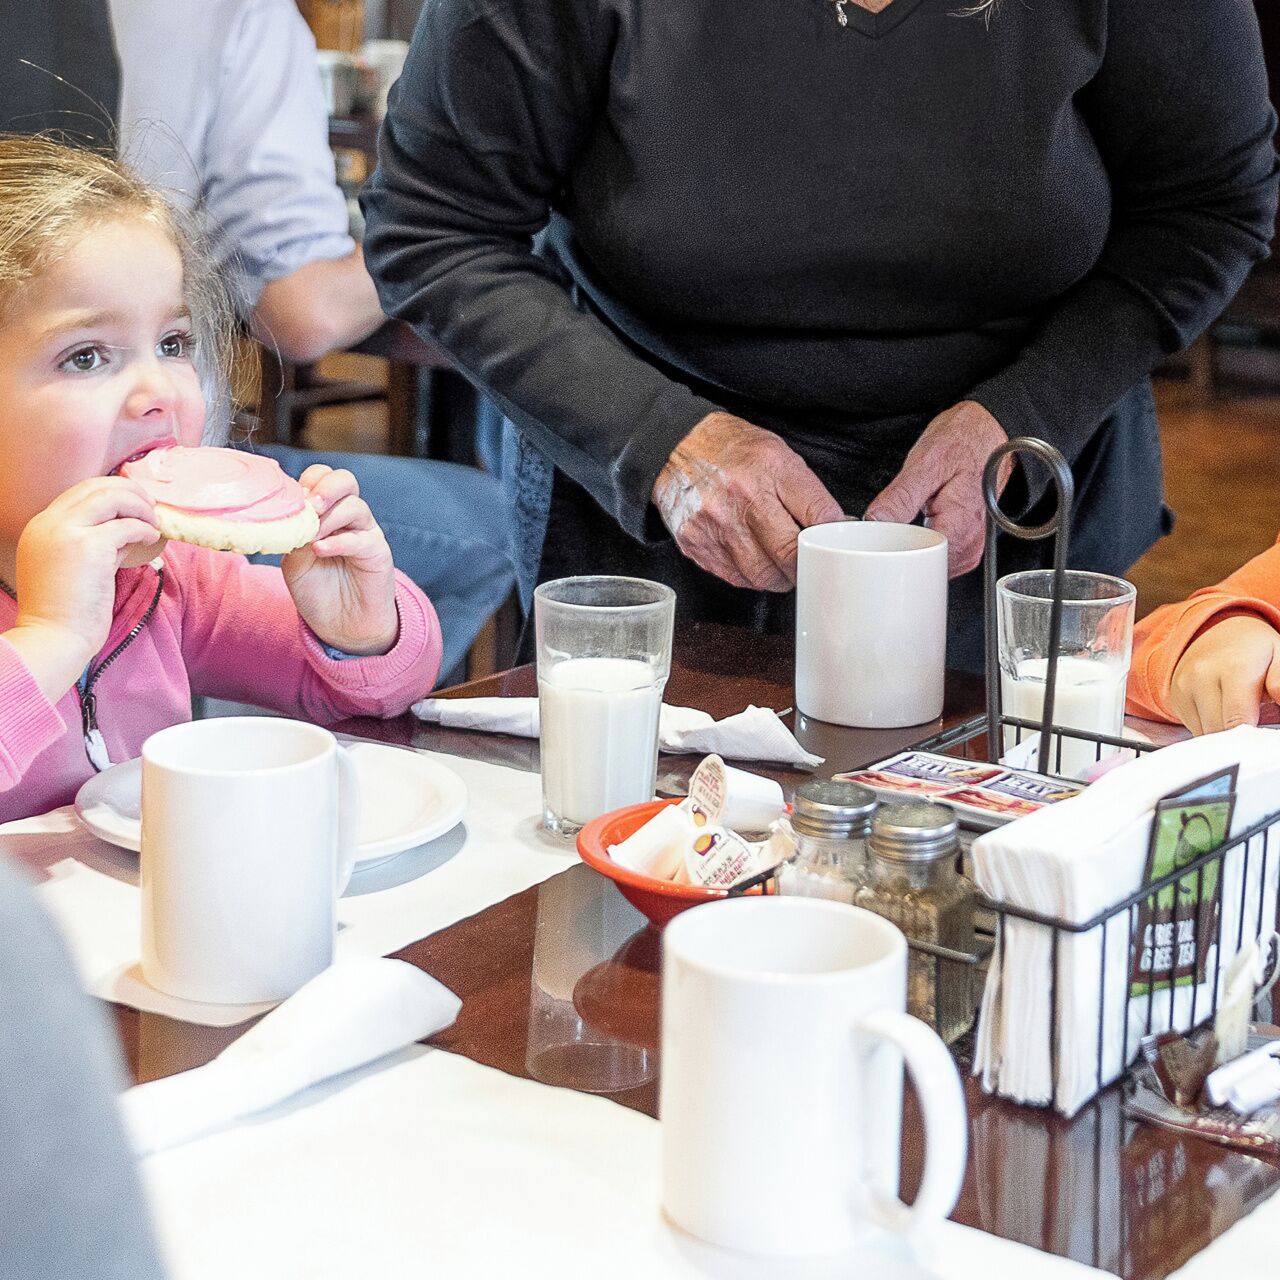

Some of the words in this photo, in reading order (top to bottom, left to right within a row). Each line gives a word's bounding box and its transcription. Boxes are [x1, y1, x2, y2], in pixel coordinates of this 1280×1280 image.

[901, 756, 962, 774] JELLY
[999, 778, 1060, 796] JELLY
[1143, 919, 1195, 948] ORIETAL
[1140, 946, 1175, 972] GREE
